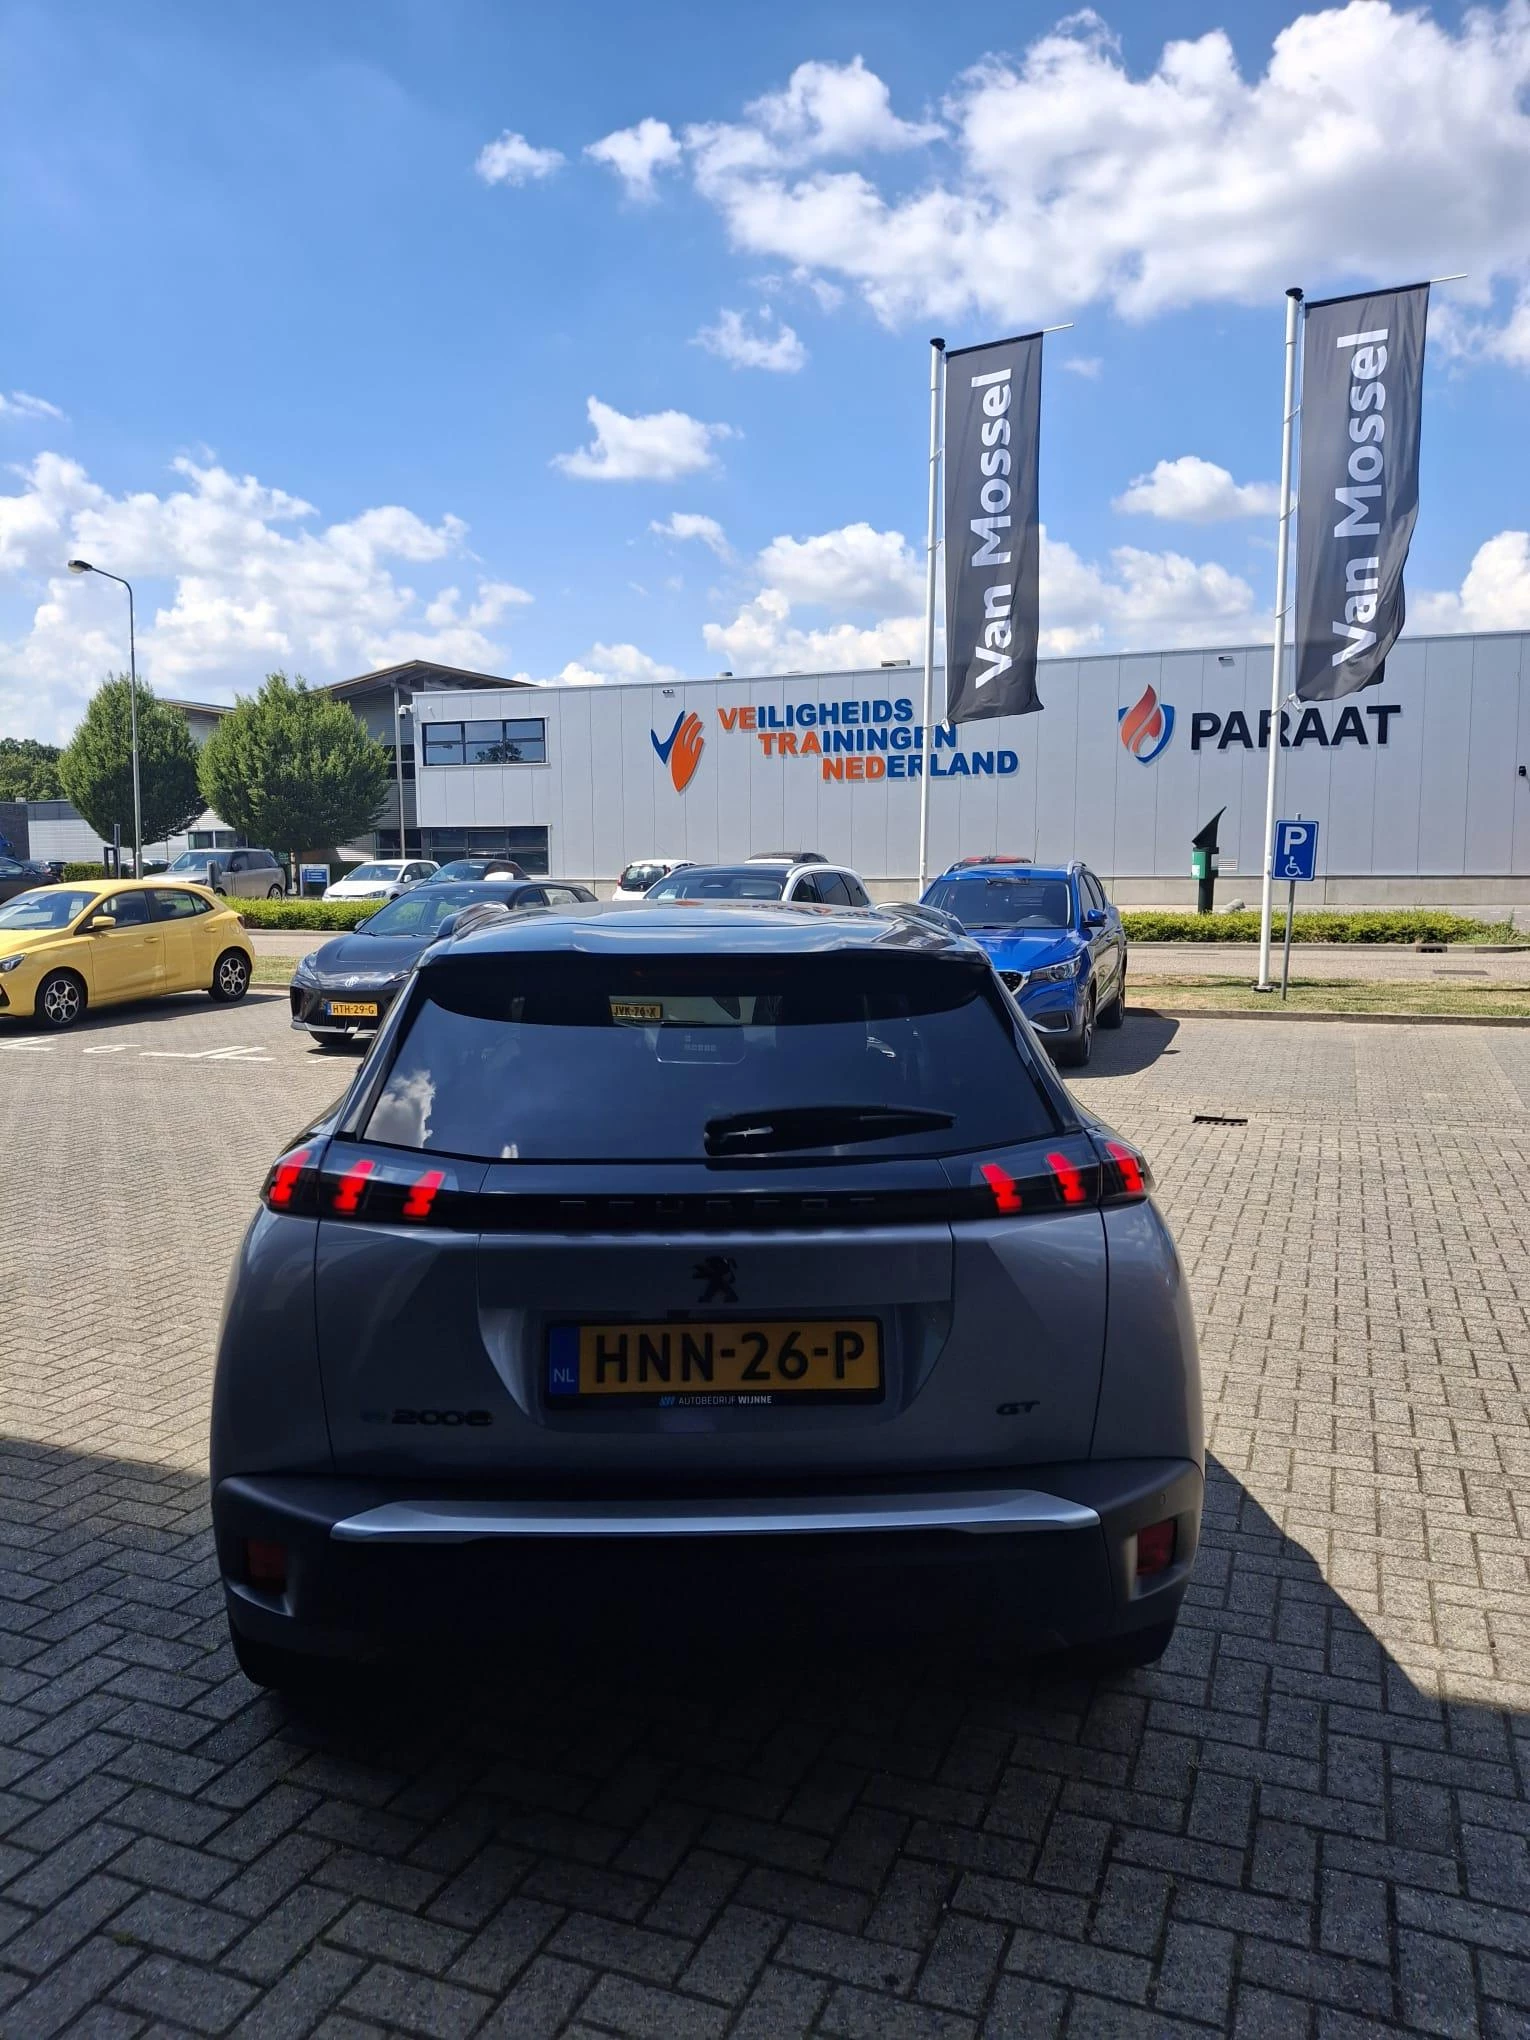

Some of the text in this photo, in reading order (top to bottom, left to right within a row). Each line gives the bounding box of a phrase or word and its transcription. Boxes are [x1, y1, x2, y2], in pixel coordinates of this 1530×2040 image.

[1332, 328, 1389, 668] Van Mossel
[970, 368, 1013, 689] Van Mossel
[718, 698, 914, 730] VEILIGHEIDS
[1191, 705, 1401, 750] PARAAT
[822, 751, 1018, 780] NEDERLAND
[1284, 826, 1307, 855] P
[332, 1004, 375, 1014] HTH-29-G
[595, 1331, 865, 1383] HNN-26-P
[553, 1369, 576, 1383] NL
[678, 1395, 735, 1405] AUTOBEDRIJF
[738, 1395, 773, 1405] WIJNNE
[996, 1400, 1041, 1415] GT
